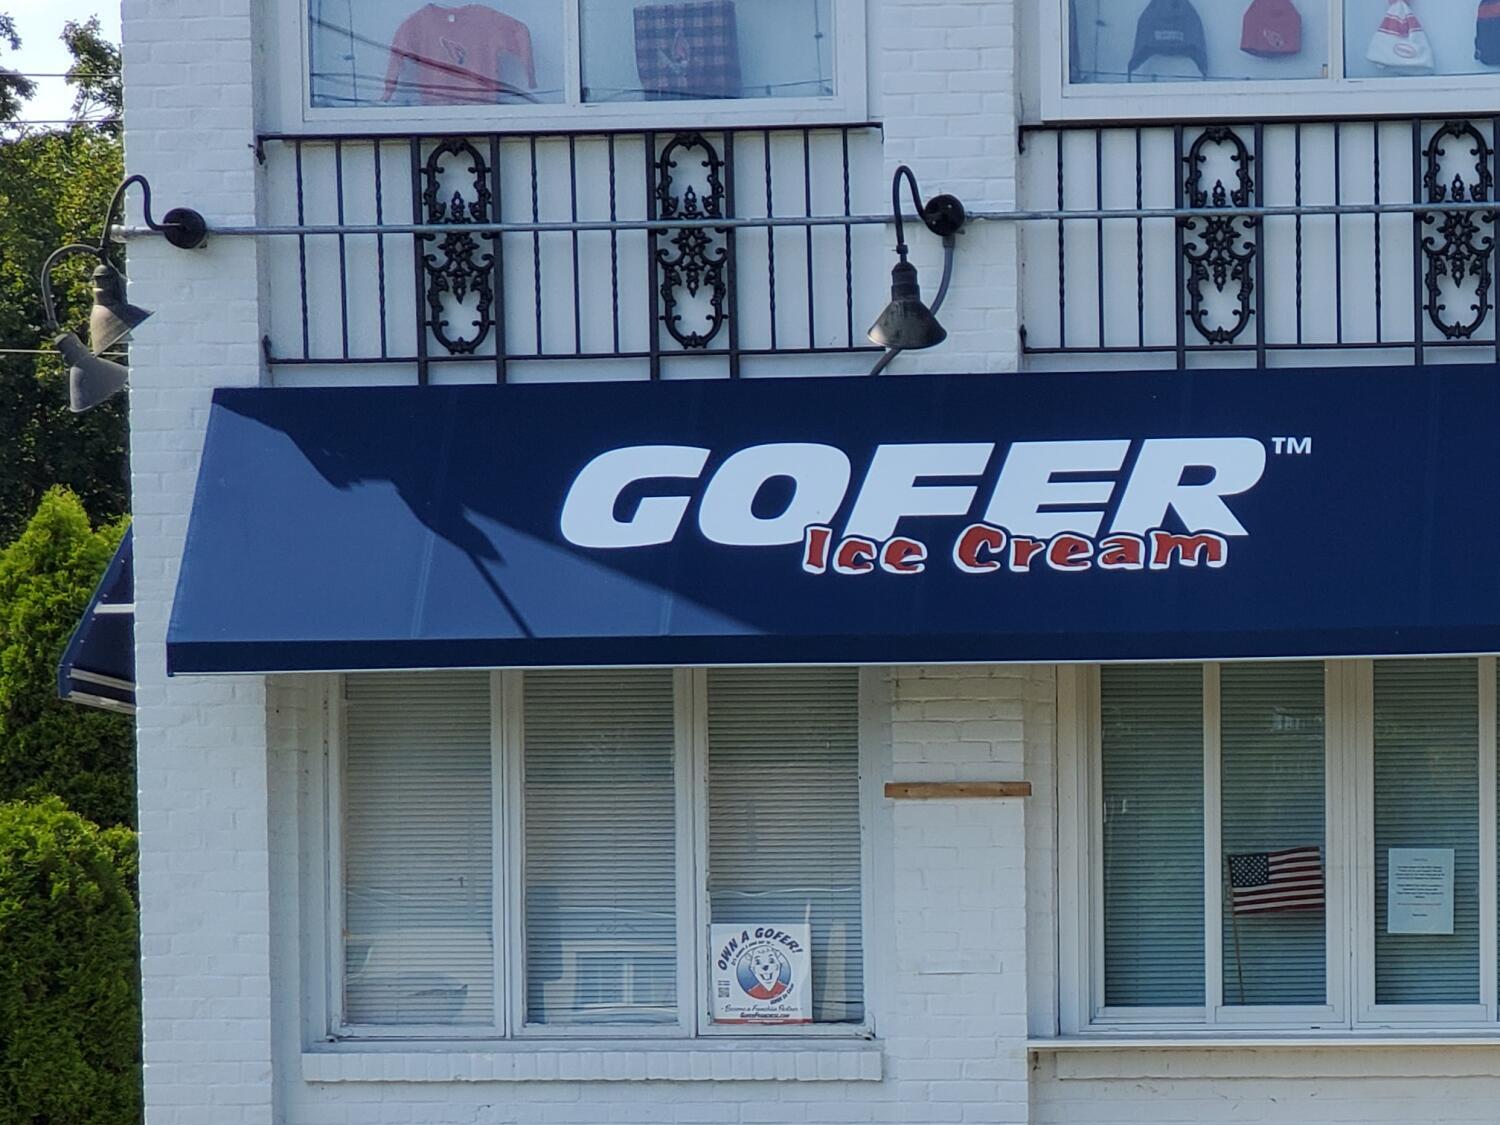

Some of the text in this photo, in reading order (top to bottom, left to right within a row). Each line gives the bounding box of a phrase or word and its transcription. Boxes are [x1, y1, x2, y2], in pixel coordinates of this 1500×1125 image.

[559, 435, 1312, 549] GOFER TM
[801, 523, 1229, 575] Ice Cream
[717, 938, 738, 971] OWN
[741, 930, 750, 944] A
[754, 927, 804, 953] GOFER!
